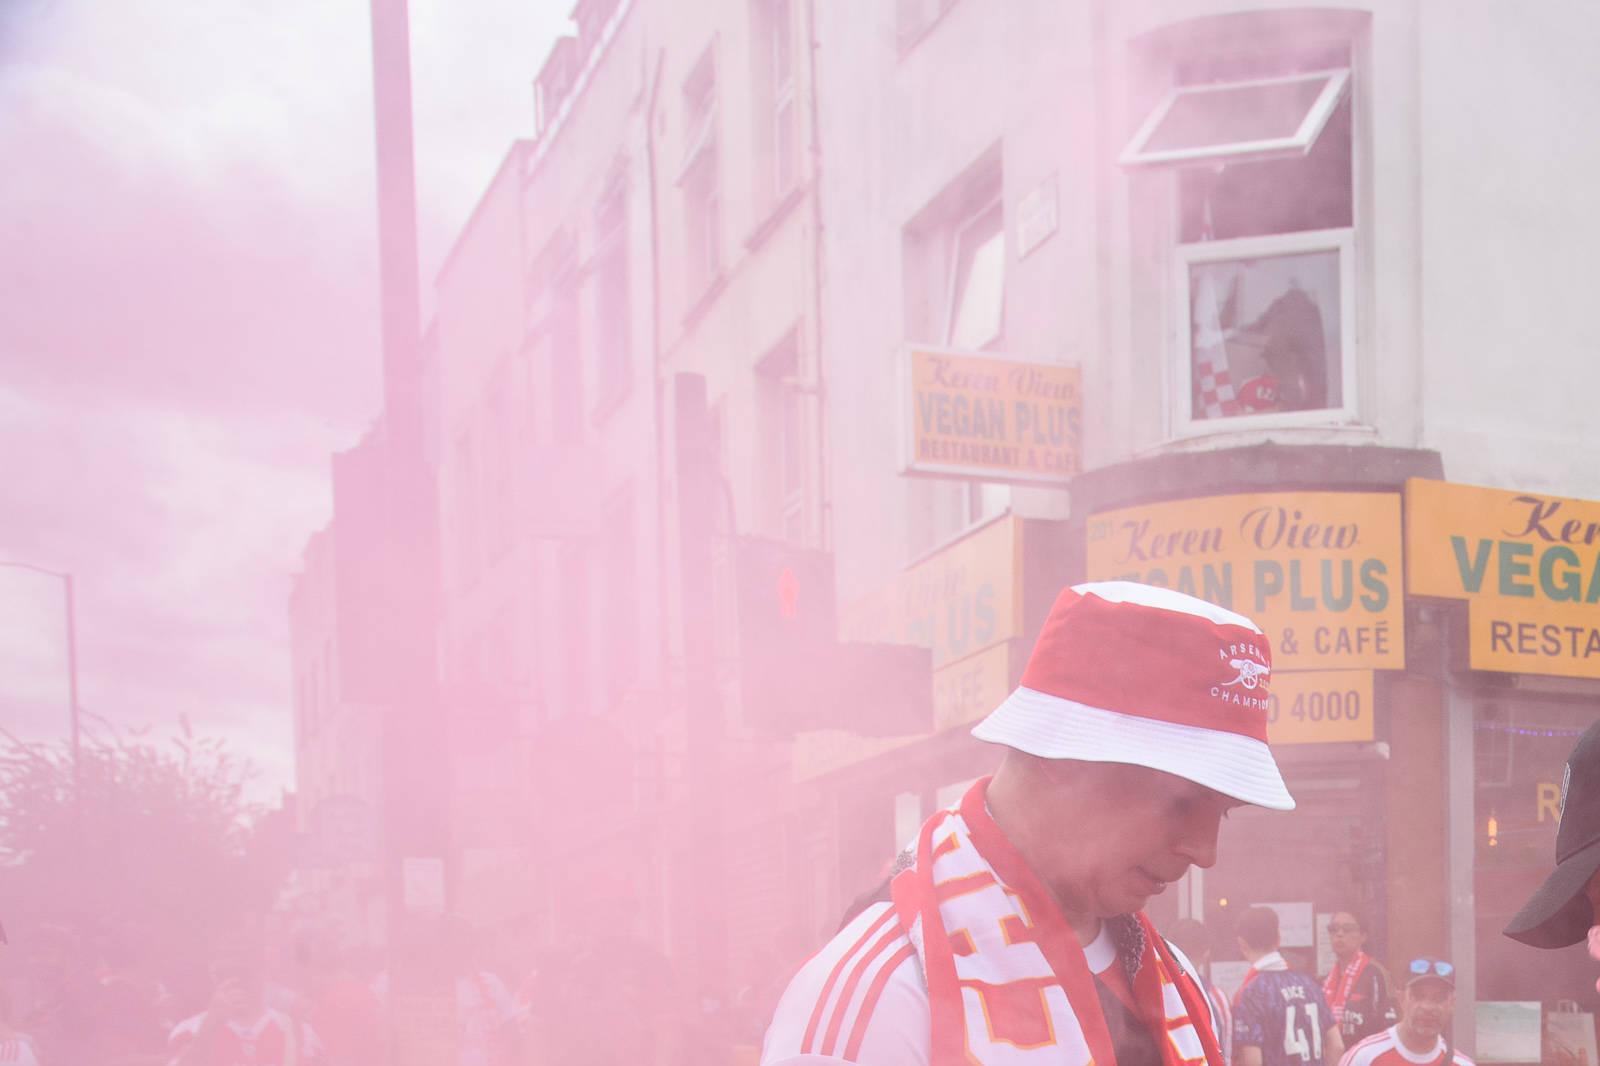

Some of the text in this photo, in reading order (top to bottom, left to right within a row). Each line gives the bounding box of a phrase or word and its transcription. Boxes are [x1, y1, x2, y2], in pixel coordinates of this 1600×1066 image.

[928, 356, 1076, 400] Keren View
[916, 390, 1082, 447] VEGAN PLUS
[920, 437, 1020, 467] RESTAURANT
[1115, 506, 1361, 564] Keren View
[1253, 558, 1390, 613] PLUS
[1281, 621, 1390, 656] & CAFÉ
[1291, 690, 1360, 723] 4000
[1281, 985, 1306, 1001] RICE
[1284, 1003, 1321, 1061] 41
